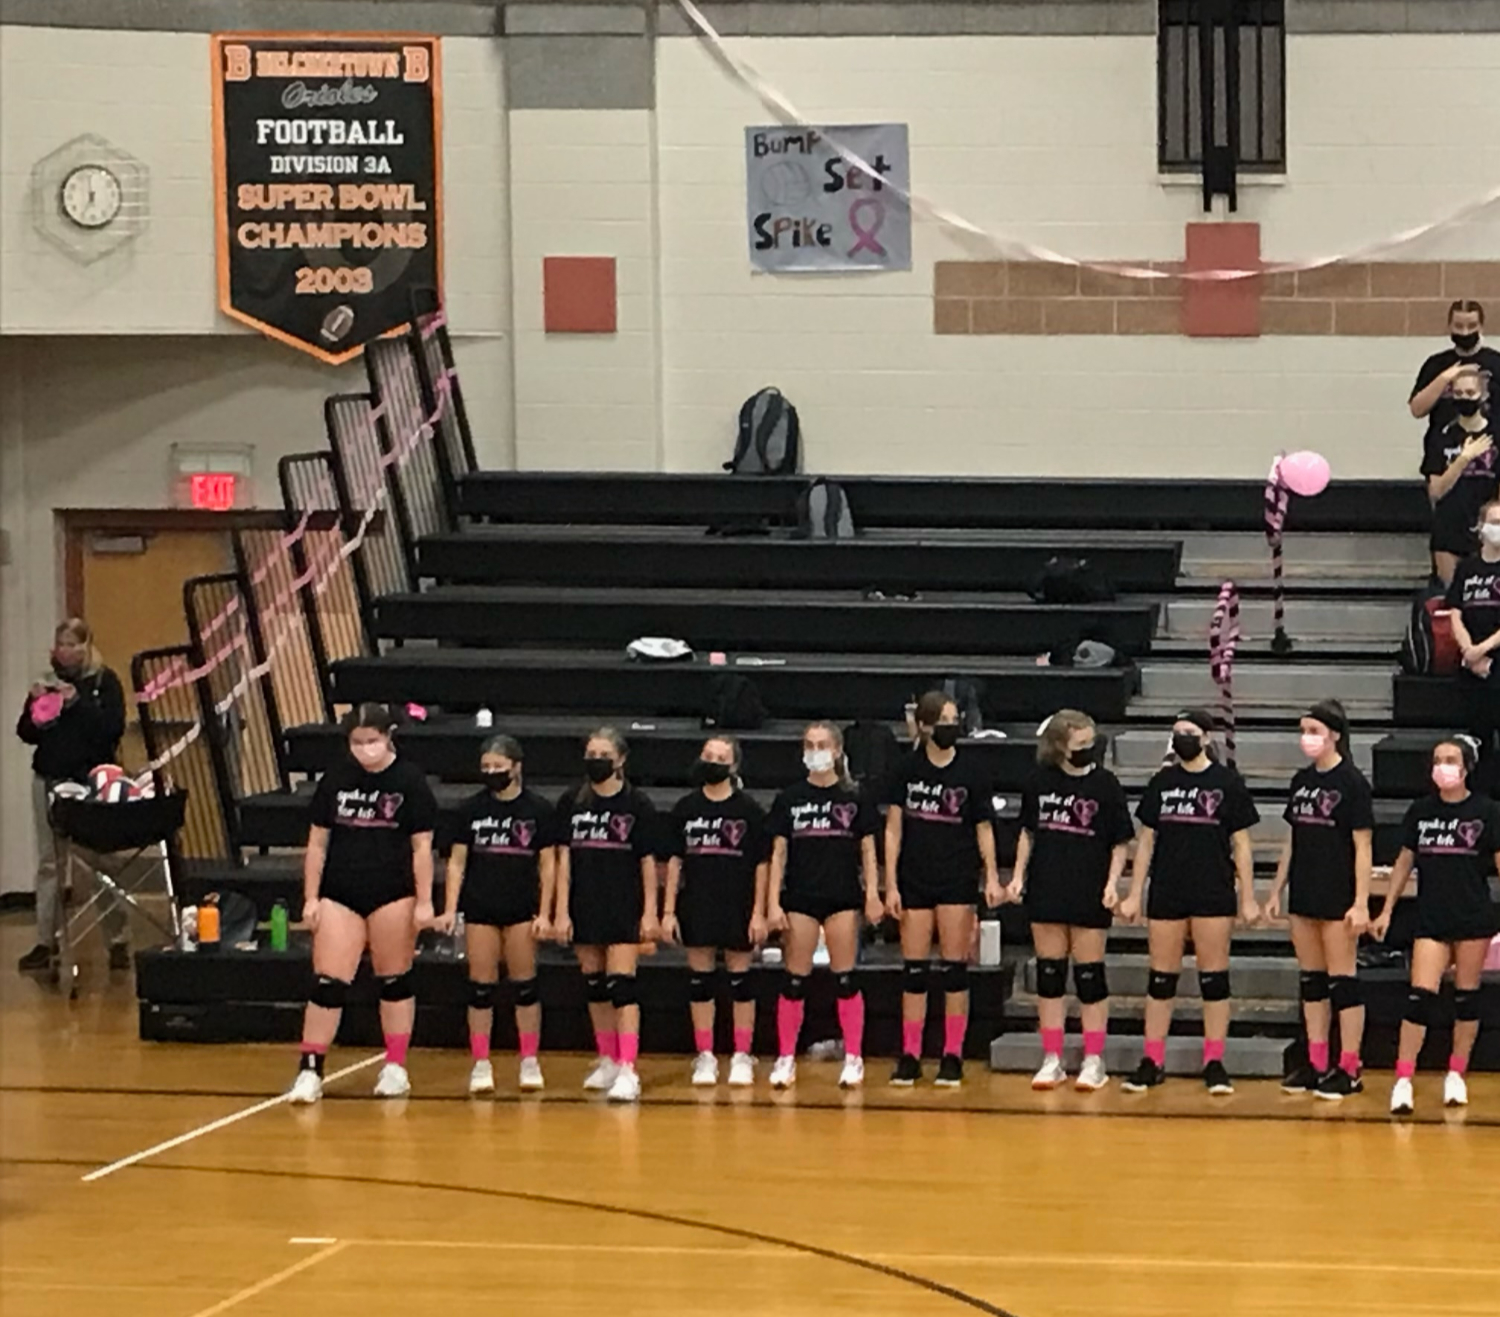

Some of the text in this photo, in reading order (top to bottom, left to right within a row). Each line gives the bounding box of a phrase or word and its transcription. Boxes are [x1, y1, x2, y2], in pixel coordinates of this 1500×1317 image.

[224, 45, 251, 82] B
[403, 46, 430, 82] B
[256, 118, 404, 145] FOOTBALL
[270, 155, 392, 174] DIVISION 3A
[823, 154, 891, 193] Set
[237, 184, 428, 210] SUPER BOWL
[237, 222, 428, 249] CHAMPIONS
[295, 267, 374, 294] 2003
[191, 474, 235, 511] EXIT
